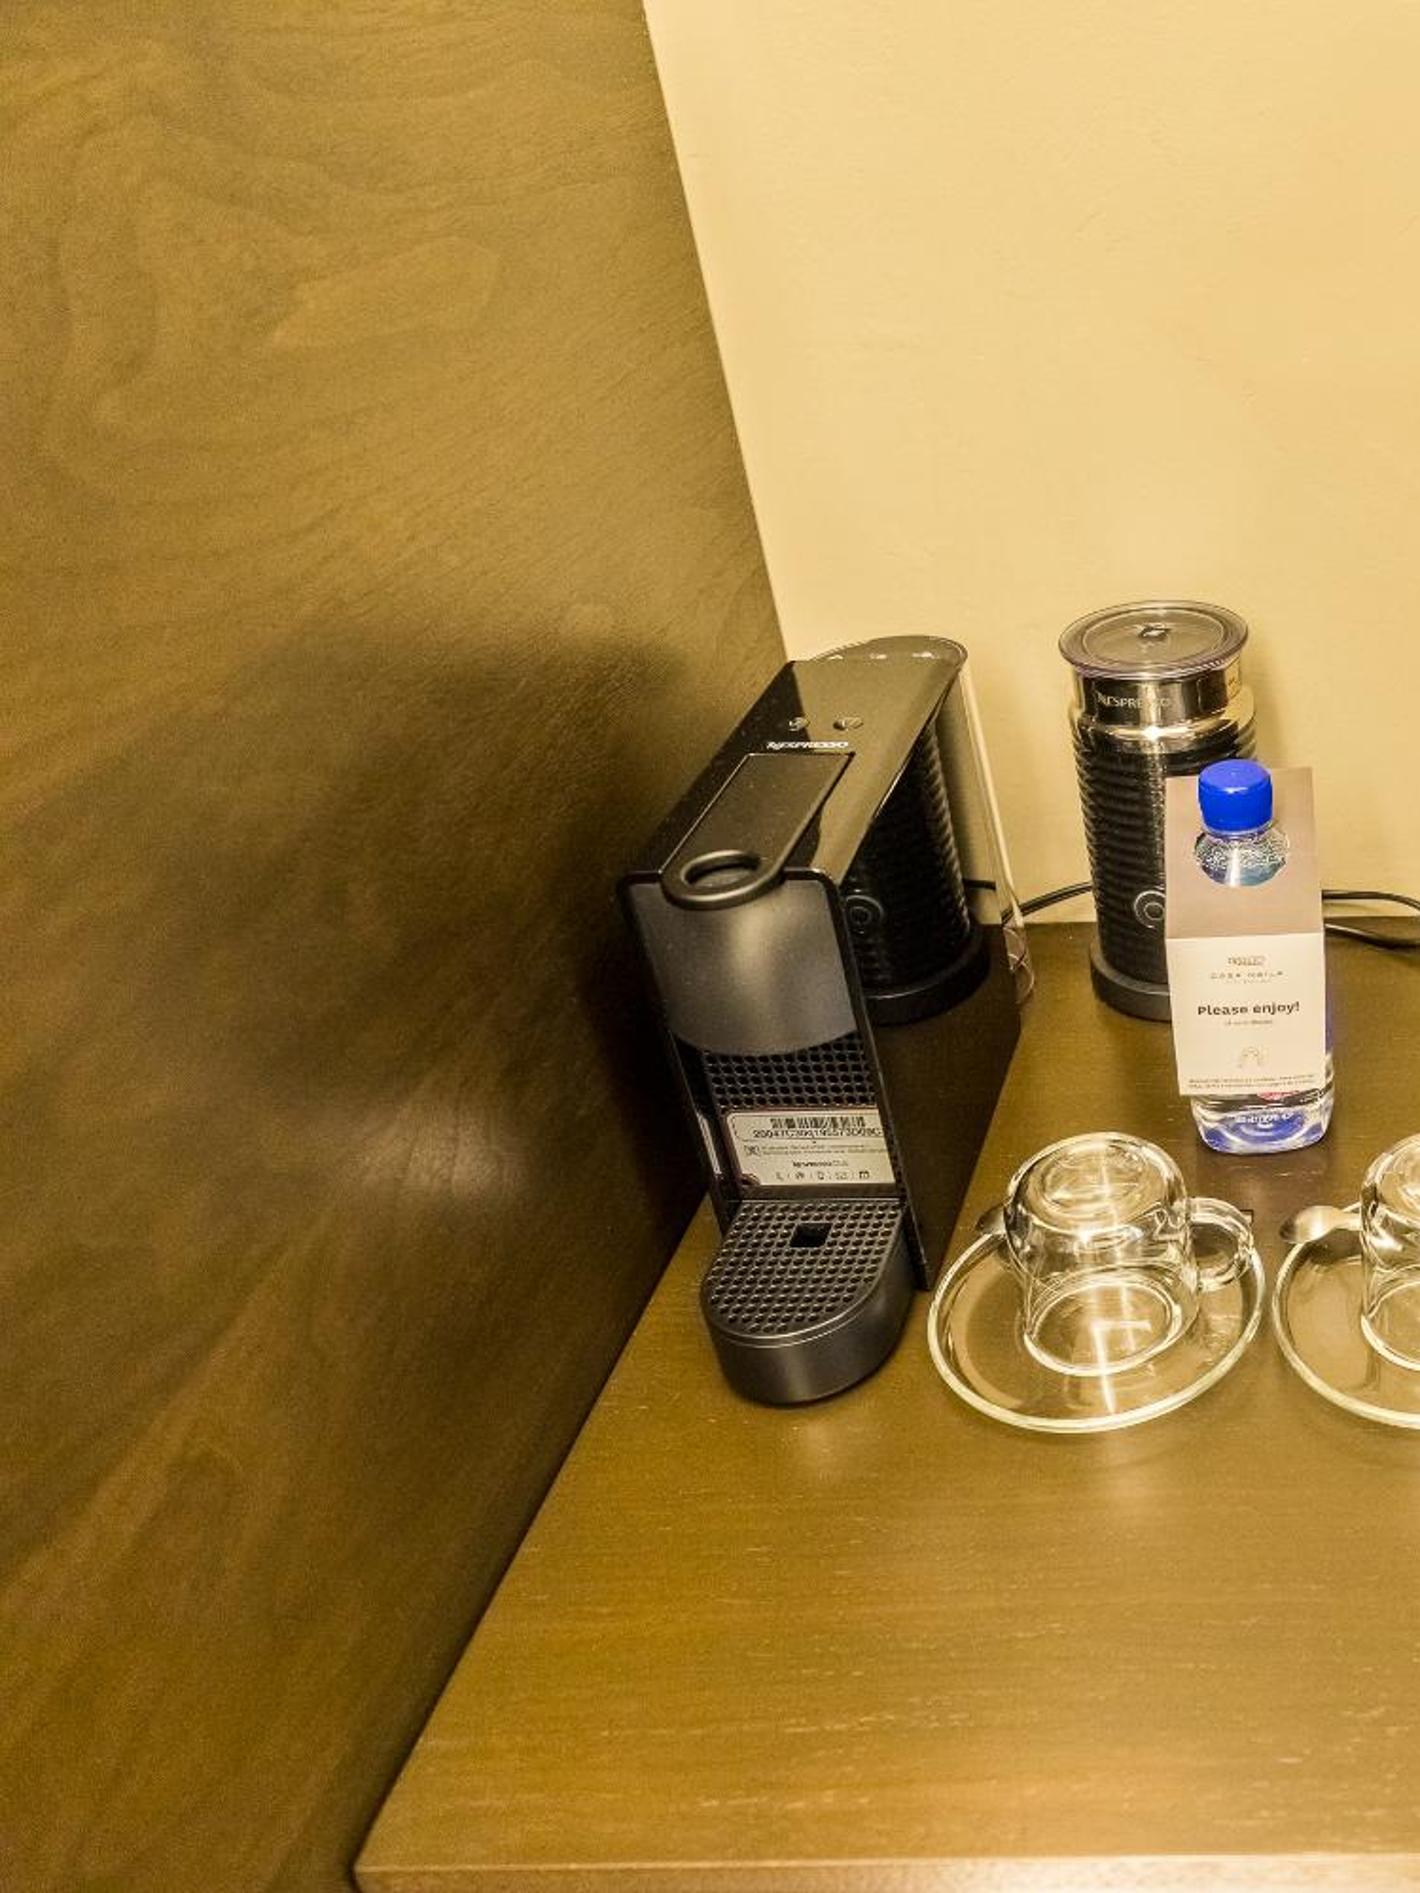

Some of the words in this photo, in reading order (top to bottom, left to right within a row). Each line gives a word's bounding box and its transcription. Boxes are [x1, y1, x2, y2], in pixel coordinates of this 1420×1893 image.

[1094, 691, 1170, 709] NESPREO
[1198, 1004, 1248, 1016] Please
[1253, 1001, 1300, 1015] enjoy!
